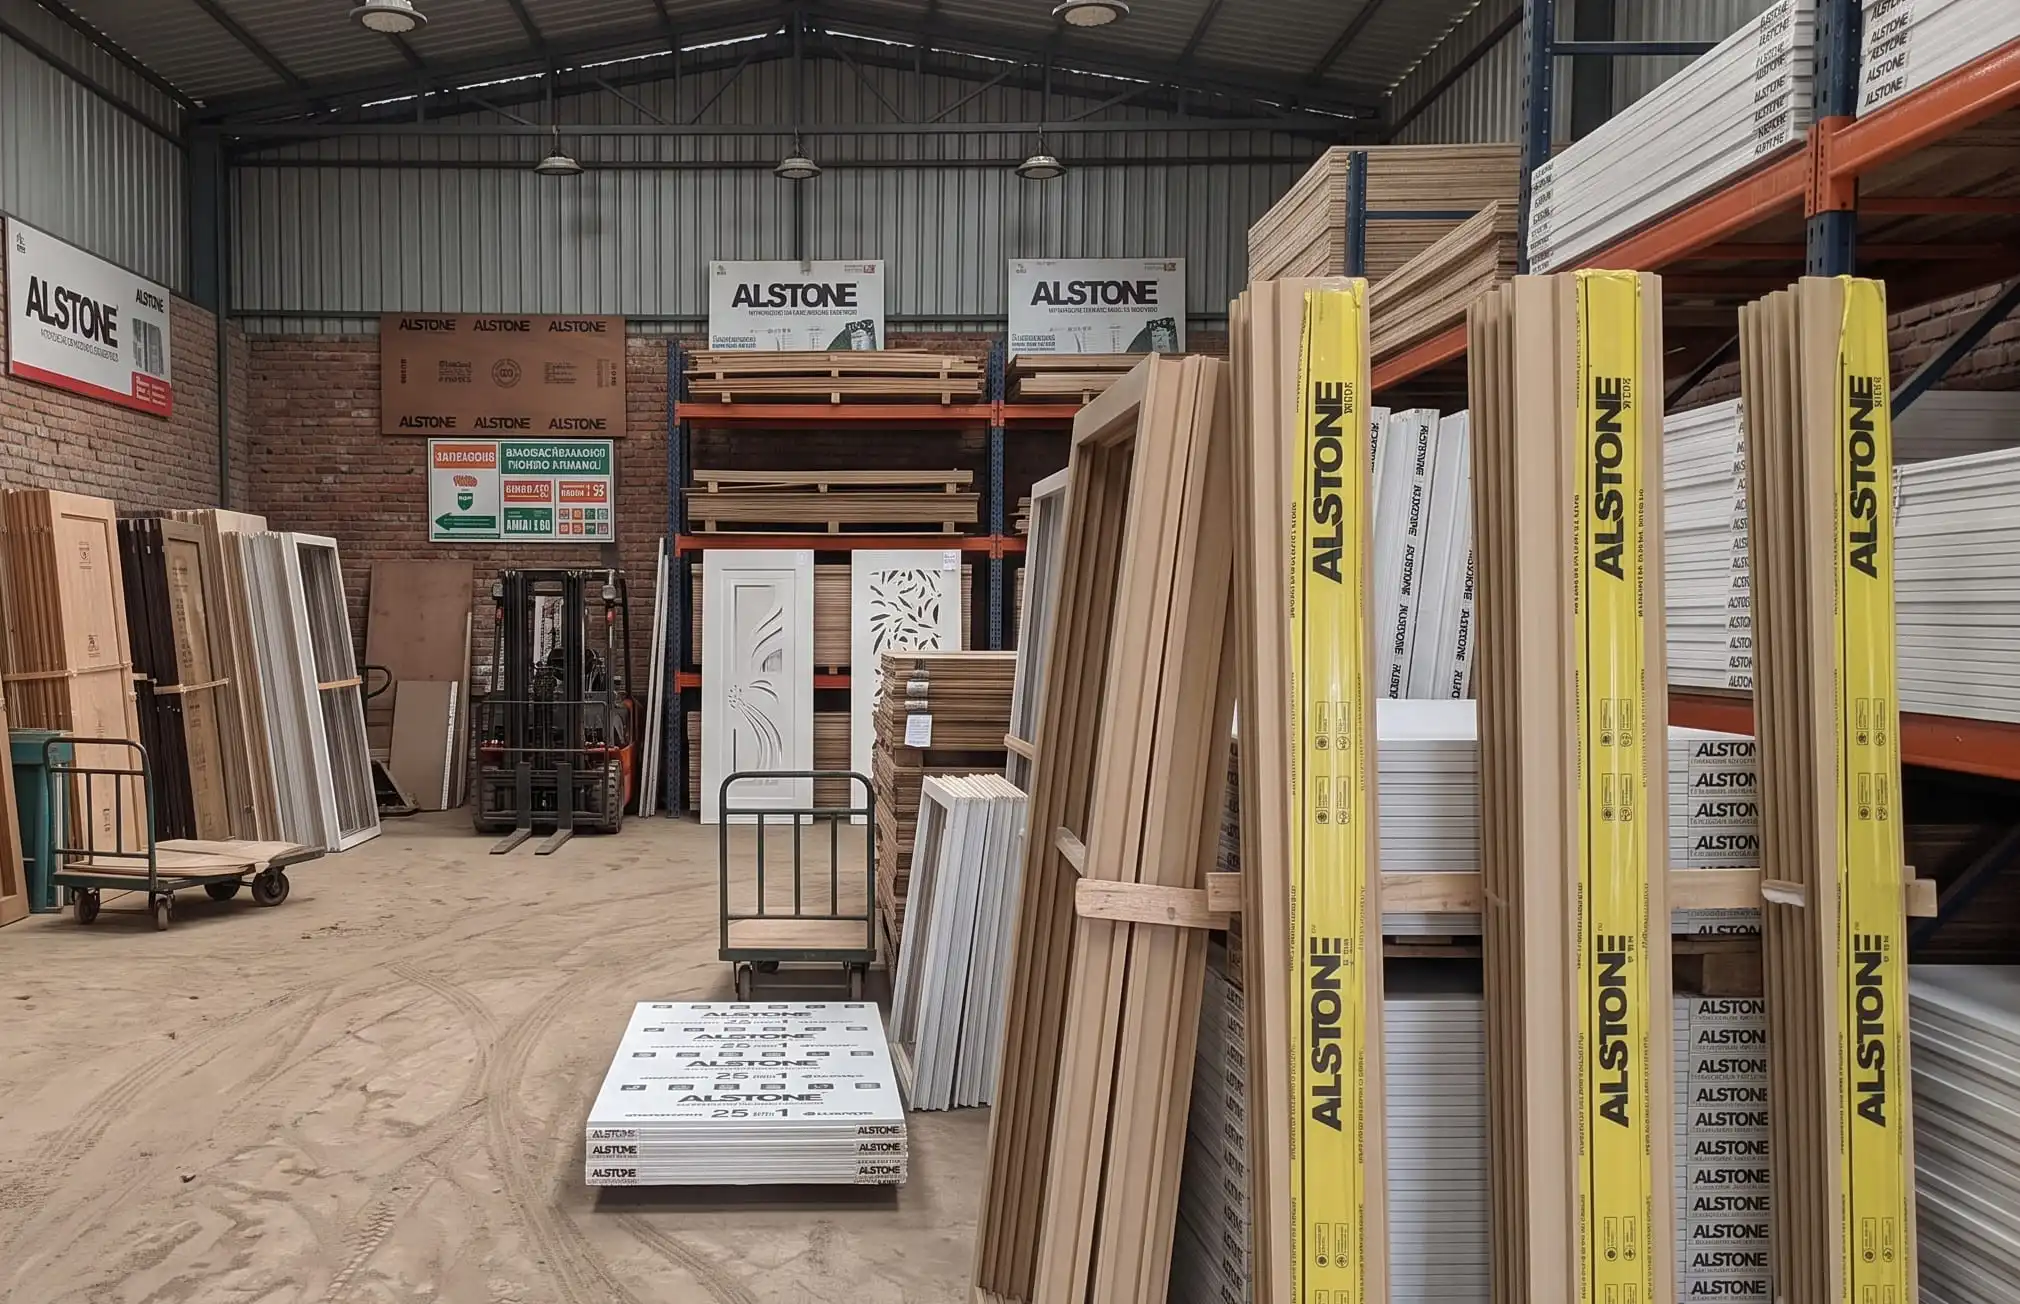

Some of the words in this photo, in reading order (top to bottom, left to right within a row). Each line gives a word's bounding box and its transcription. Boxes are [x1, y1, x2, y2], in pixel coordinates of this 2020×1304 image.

[136, 288, 164, 313] ALSTONE
[731, 283, 858, 308] ALSTONE
[1030, 280, 1158, 306] ALSTONE
[25, 275, 118, 348] ALSTONE
[399, 319, 456, 331] ALSTONE
[473, 320, 531, 332] ALSTONE
[548, 320, 606, 333] ALSTONE
[399, 416, 456, 429] ALSTONE
[474, 417, 531, 429] ALSTONE
[548, 418, 606, 430] ALSTONE
[1312, 381, 1343, 584] ALSTONE
[1594, 376, 1624, 581] ALSTONE
[1850, 375, 1878, 579] ALSTONE
[1310, 936, 1342, 1132] ALSTONE
[1597, 934, 1629, 1128] ALSTONE
[1854, 933, 1886, 1128] ALSTONE
[685, 1060, 819, 1068] ALSTONE
[715, 1072, 749, 1080] 25
[677, 1093, 823, 1103] ALSTONE
[711, 1109, 749, 1118] 25
[775, 1108, 788, 1117] 1
[1695, 1111, 1768, 1126] ALSTONE
[1695, 1140, 1769, 1155] ALSTONE
[1693, 1168, 1770, 1184] ALSTONE
[1693, 1196, 1770, 1211] ALSTONE
[1692, 1224, 1769, 1238] ALSTONE
[1692, 1252, 1768, 1267] ALSTONE
[1691, 1280, 1766, 1295] ALSTONE
